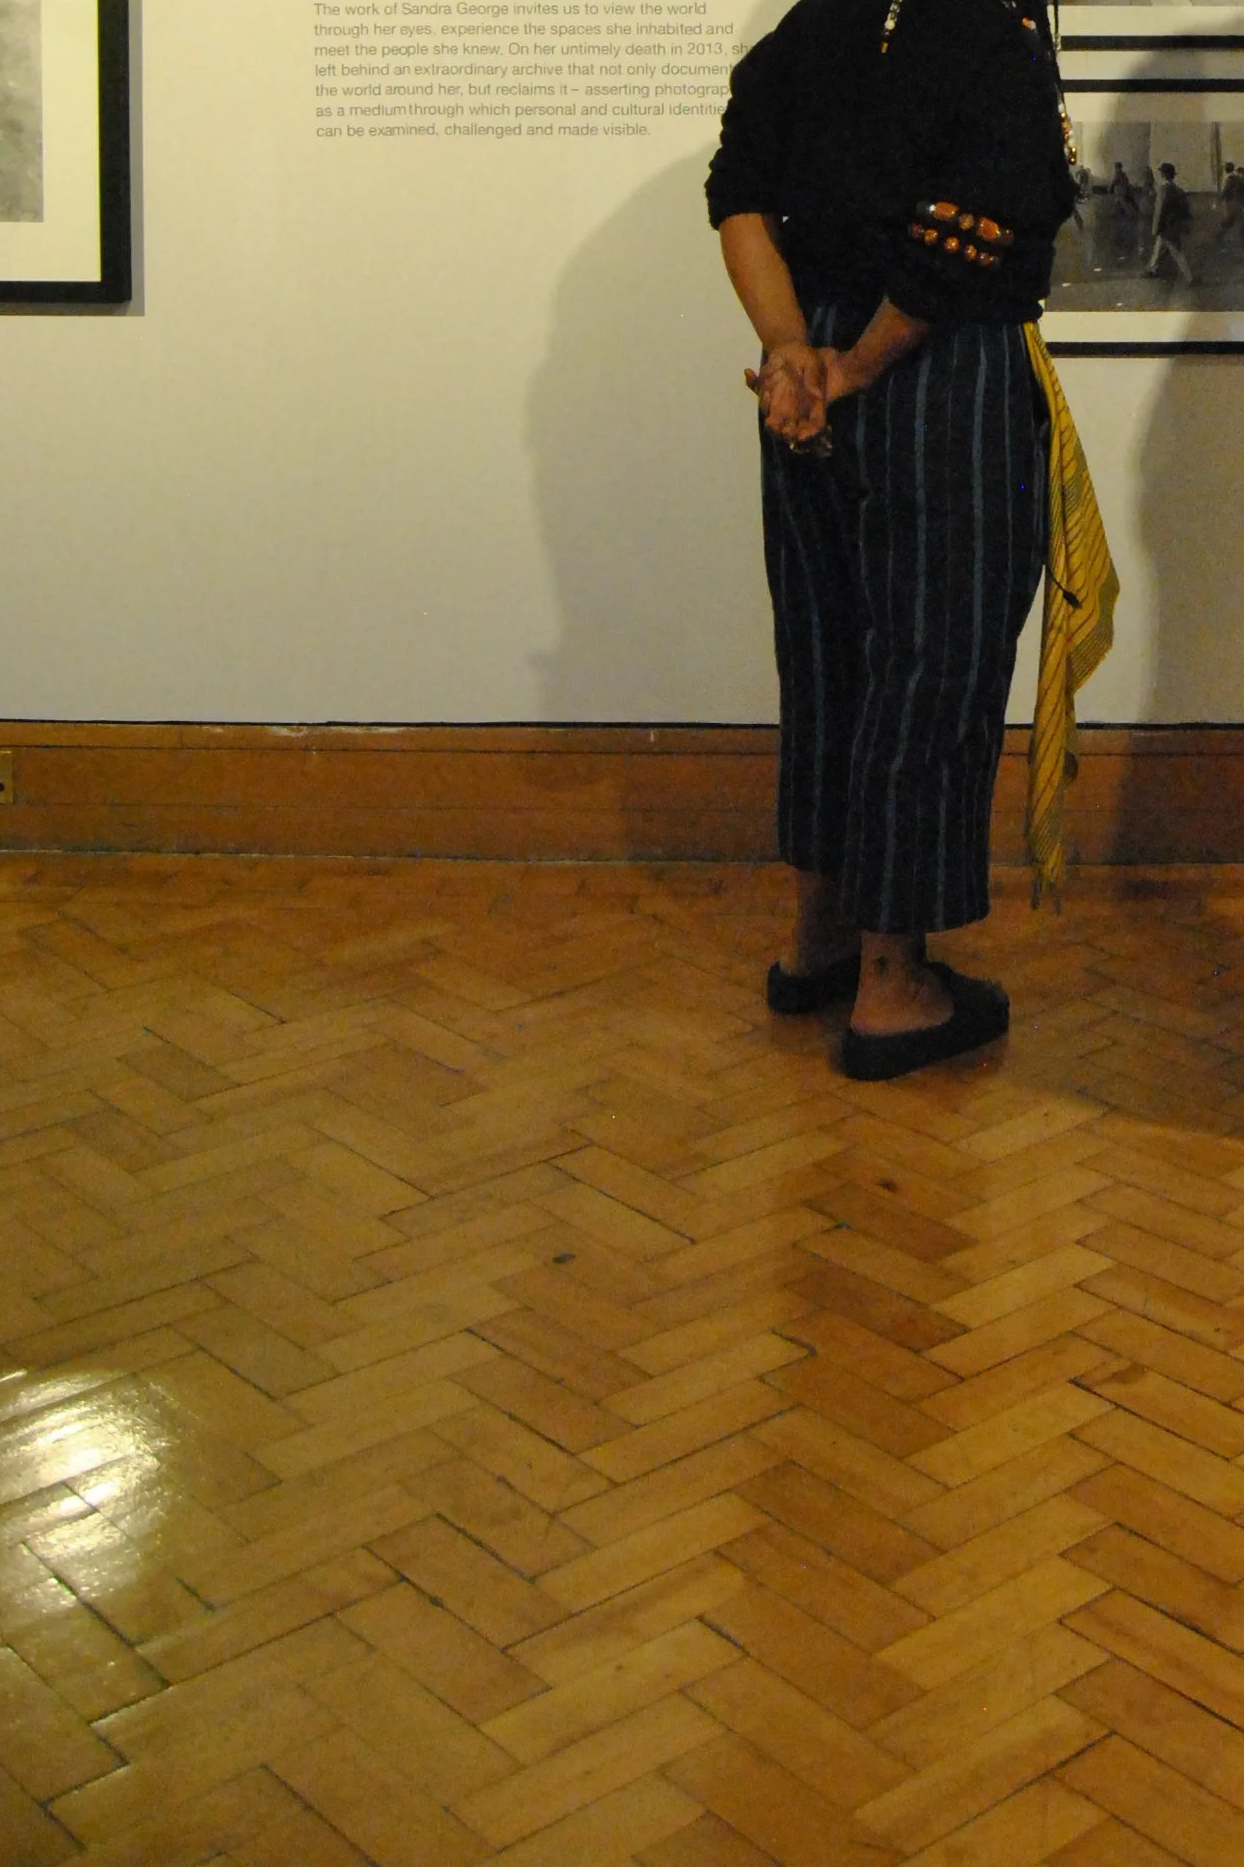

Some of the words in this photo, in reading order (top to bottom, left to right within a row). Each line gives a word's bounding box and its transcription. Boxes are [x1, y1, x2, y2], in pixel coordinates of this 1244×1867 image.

[313, 3, 340, 16] The
[344, 3, 379, 15] work
[402, 2, 452, 15] Sandra
[456, 1, 509, 18] George
[513, 2, 559, 15] invites
[603, 3, 635, 15] view
[640, 2, 663, 15] the
[667, 2, 706, 15] world
[314, 23, 369, 39] through
[374, 23, 396, 35] her
[400, 25, 436, 38] eyes,
[441, 23, 519, 37] experience
[523, 22, 546, 35] the
[550, 25, 601, 37] spaces
[606, 23, 632, 35] she
[636, 23, 702, 35] inhabited
[706, 23, 733, 35] and
[314, 43, 350, 56] meet
[355, 43, 377, 56] the
[381, 43, 429, 58] people
[433, 43, 458, 55] she
[463, 43, 503, 55] knew.
[534, 43, 556, 55] her
[561, 42, 621, 58] untimely
[625, 43, 666, 55] death
[687, 42, 728, 55] 2013,
[315, 64, 336, 77] left
[341, 63, 390, 76] behind
[414, 63, 508, 78] extraordinary
[512, 63, 563, 75] archive
[568, 63, 594, 75] that
[627, 63, 656, 78] only
[661, 63, 736, 75] document
[315, 84, 338, 97] the
[342, 84, 381, 96] world
[385, 84, 433, 95] around
[438, 83, 463, 96] her,
[496, 83, 555, 95] reclaims
[585, 84, 650, 98] asserting
[349, 104, 406, 116] medium
[409, 103, 464, 118] through
[469, 103, 510, 115] which
[515, 103, 576, 117] personal
[581, 104, 607, 116] and
[612, 103, 664, 116] cultural
[669, 103, 729, 116] identitie
[368, 123, 439, 137] examined,
[444, 123, 522, 139] challenged
[526, 123, 553, 136] and
[558, 123, 598, 136] made
[603, 123, 650, 136] visible.
